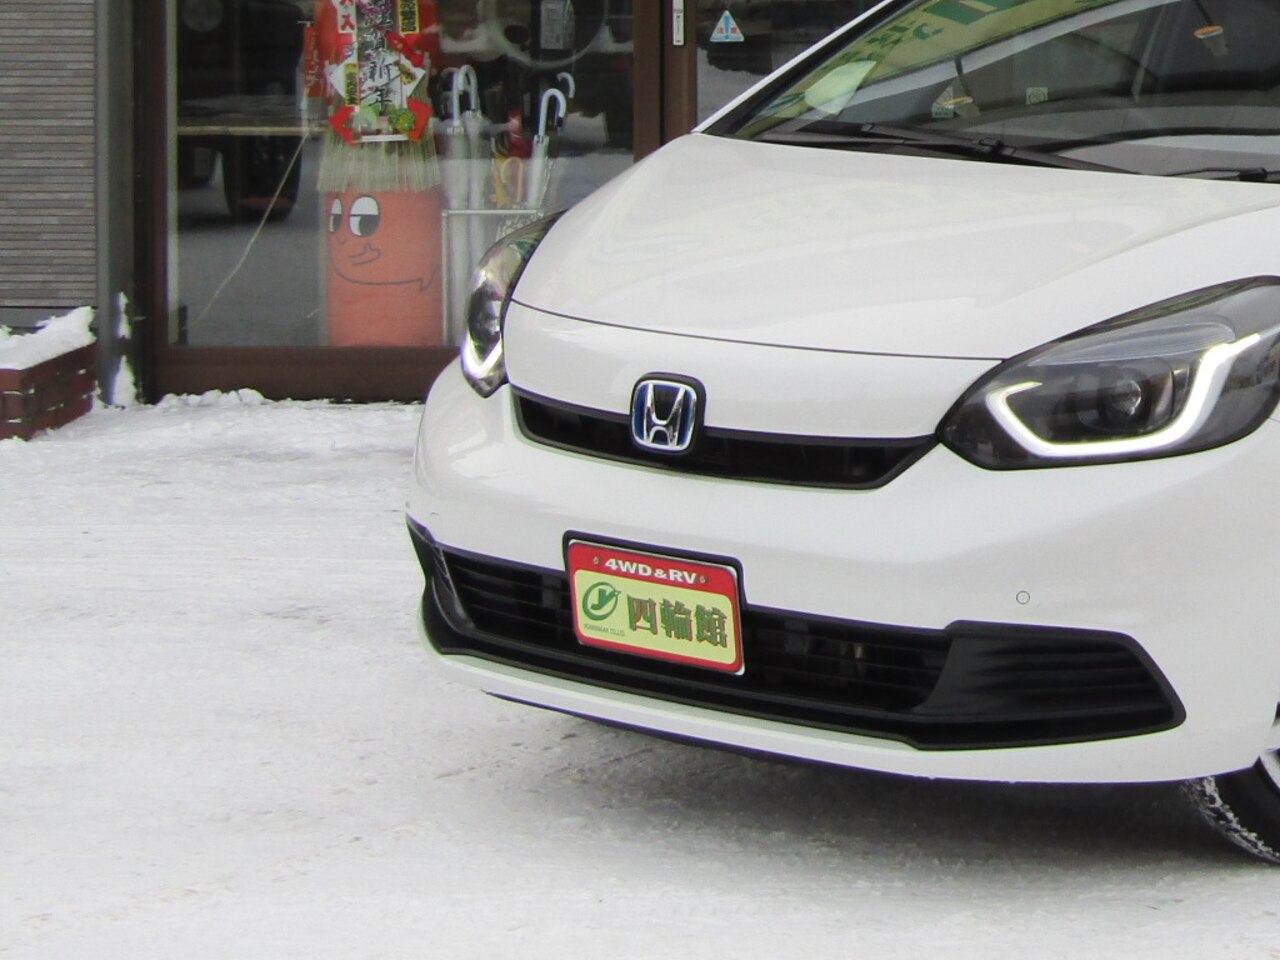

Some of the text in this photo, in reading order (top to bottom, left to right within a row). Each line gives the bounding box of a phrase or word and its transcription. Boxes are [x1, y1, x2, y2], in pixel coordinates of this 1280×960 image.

[605, 558, 697, 584] 4WD&RV
[627, 593, 728, 649] 四輪館
